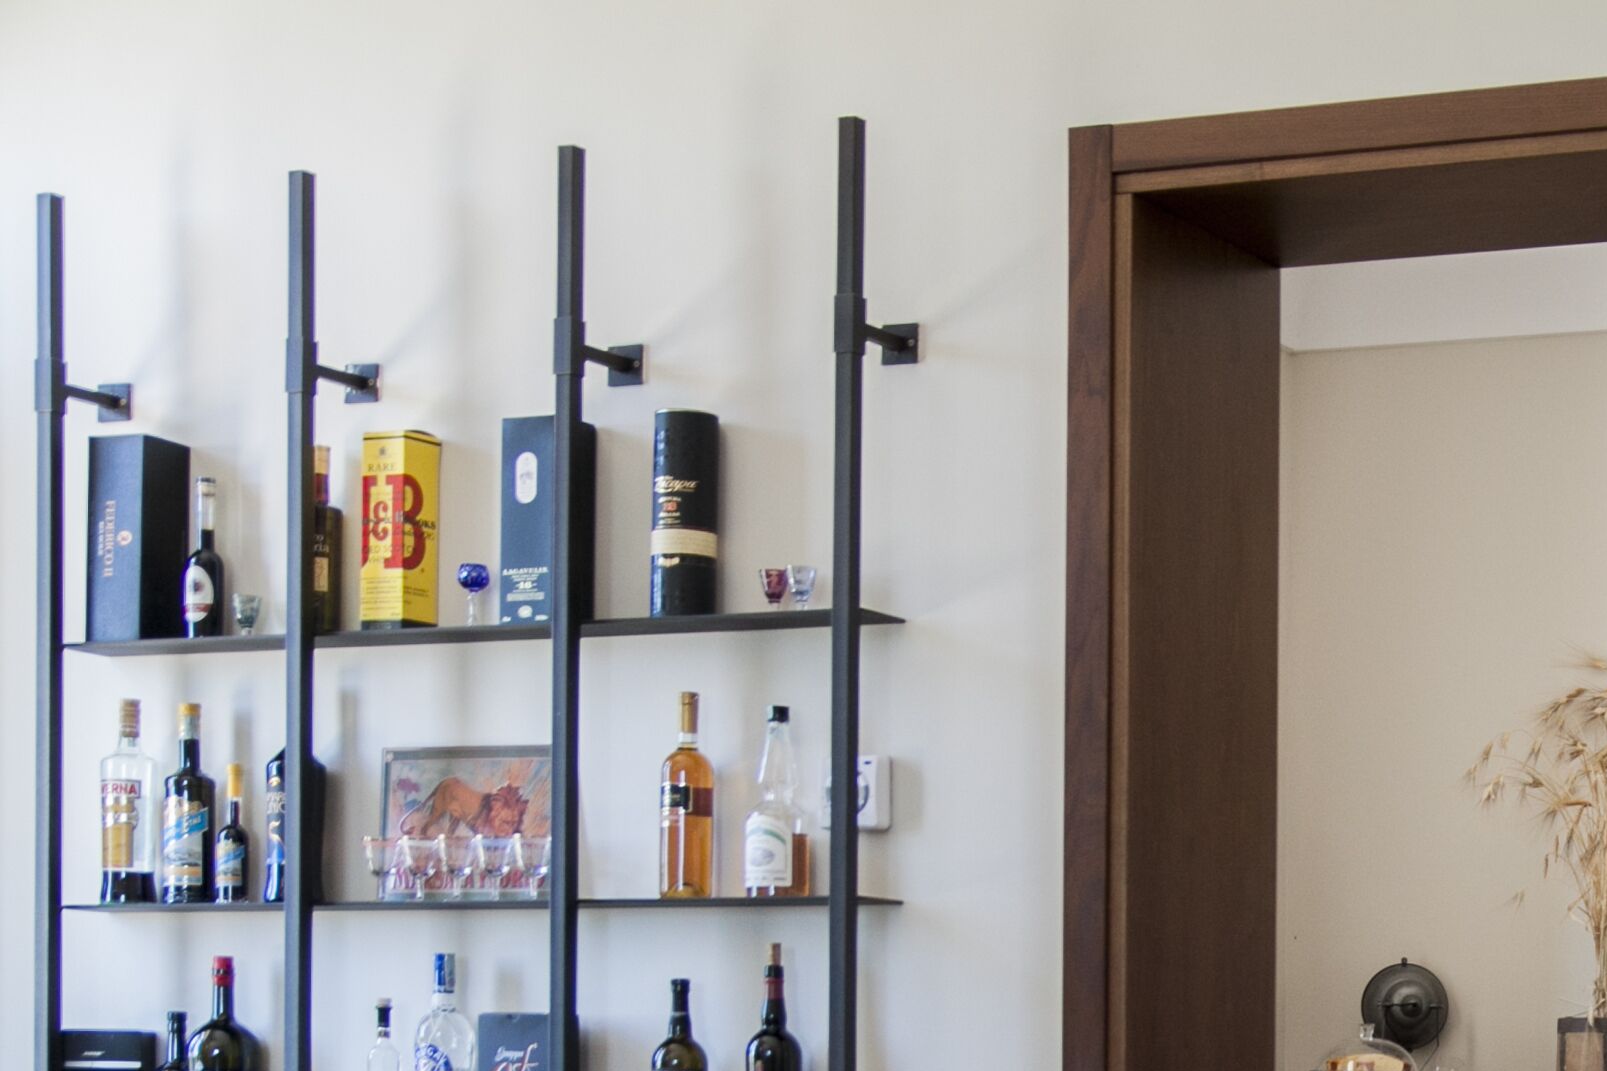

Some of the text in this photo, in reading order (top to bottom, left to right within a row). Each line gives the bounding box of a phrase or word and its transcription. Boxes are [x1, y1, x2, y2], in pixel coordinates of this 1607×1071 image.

[367, 463, 397, 472] RARE
[103, 500, 115, 577] FEDERICO II
[518, 581, 533, 589] 16
[101, 782, 138, 795] VERNA
